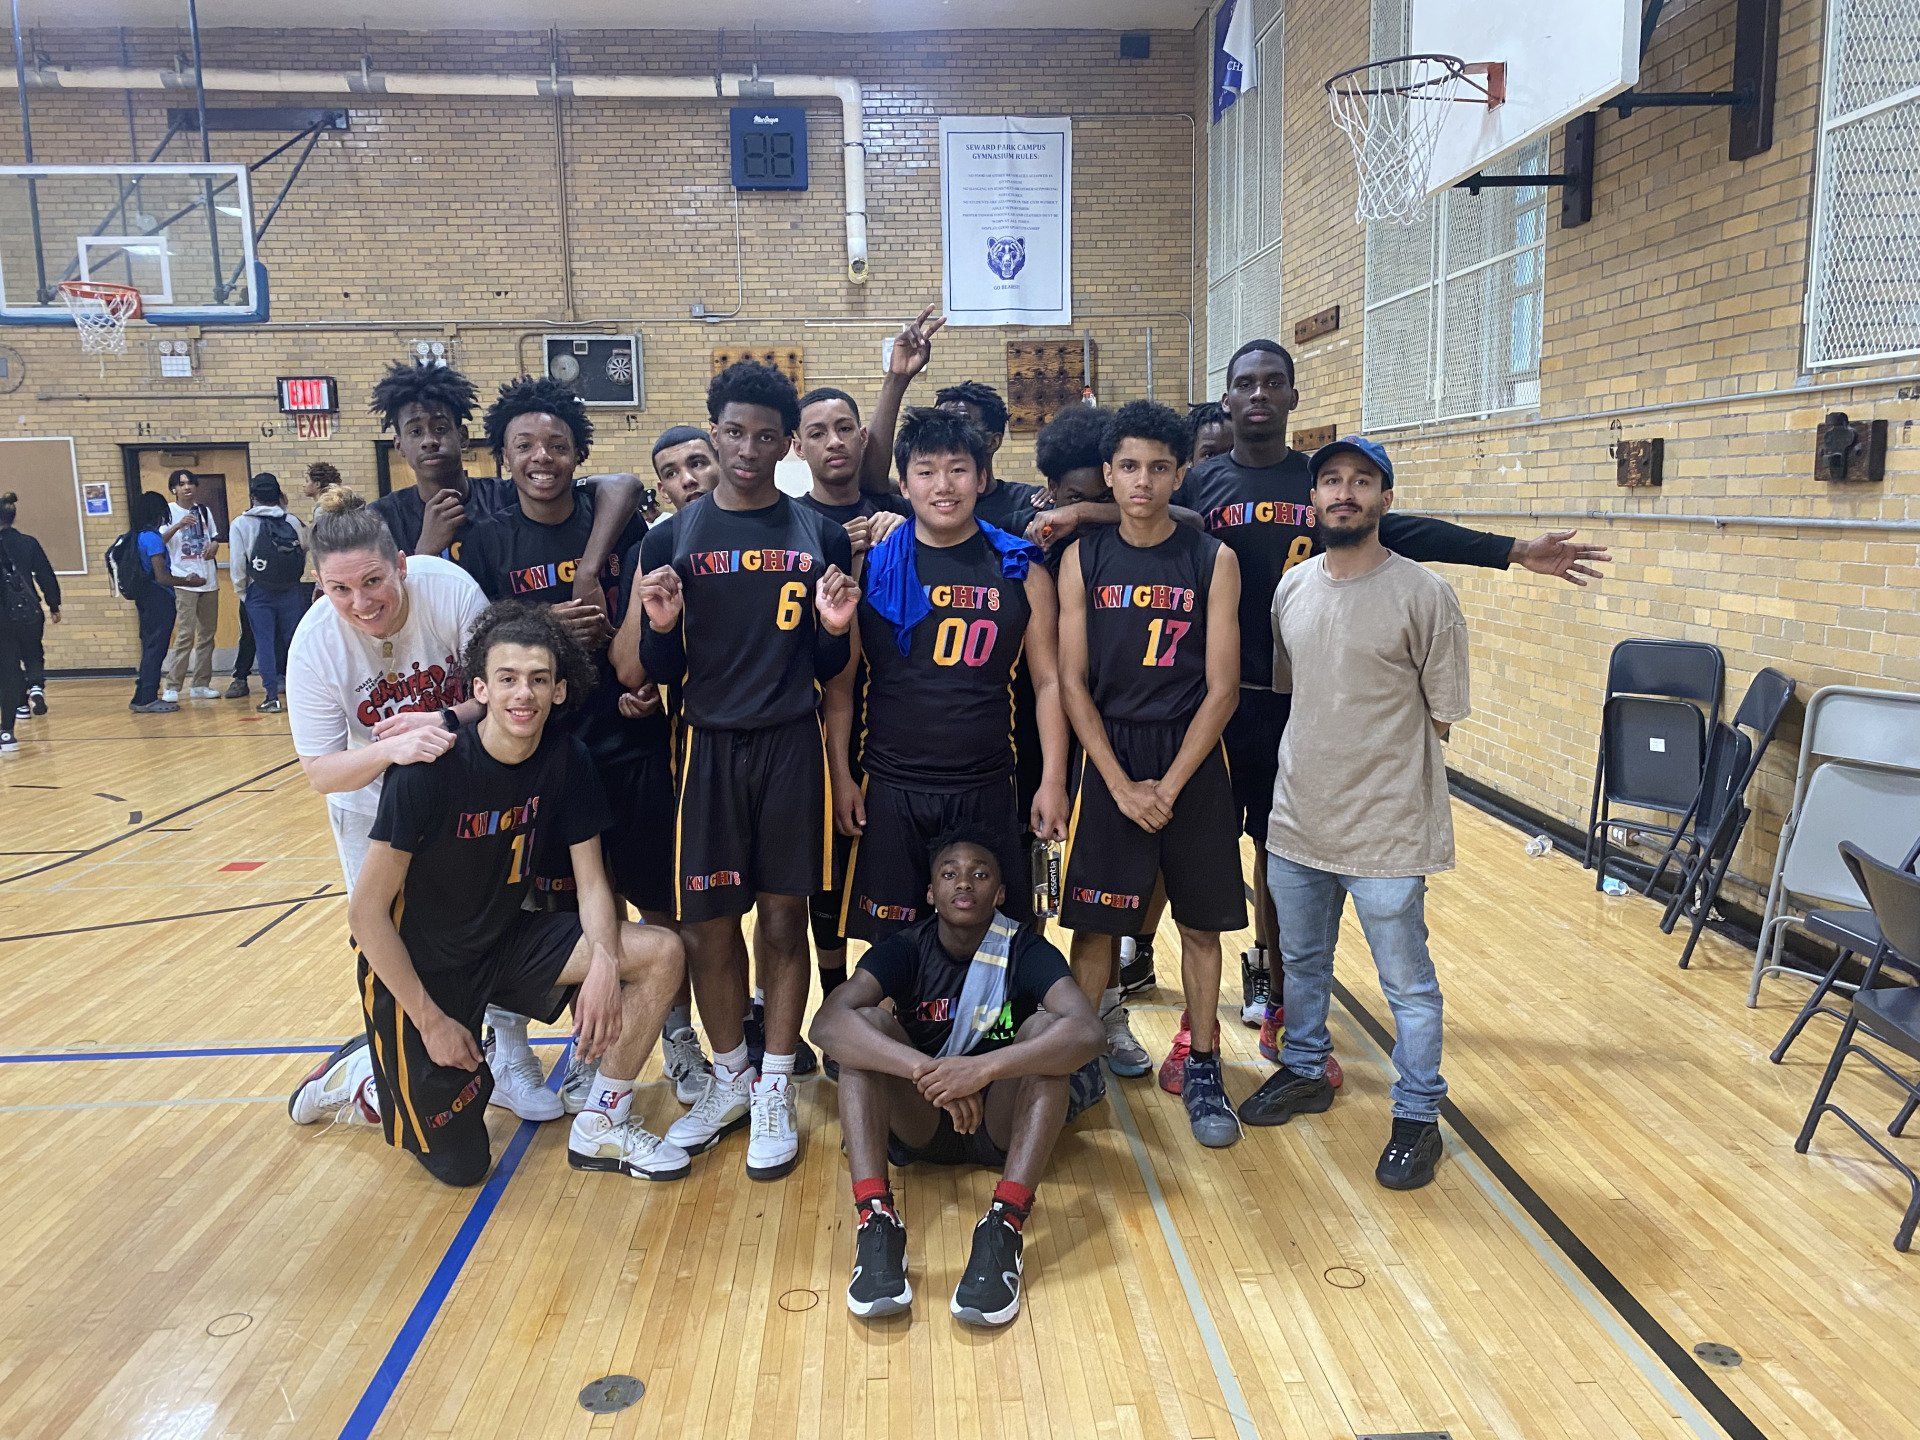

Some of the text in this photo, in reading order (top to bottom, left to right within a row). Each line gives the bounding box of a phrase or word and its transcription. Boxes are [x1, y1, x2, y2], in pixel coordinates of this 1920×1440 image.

[297, 414, 329, 437] EXIT
[1209, 501, 1316, 530] KNIGHTS
[689, 549, 814, 577] KNIGHTS
[775, 581, 808, 631] 6
[1093, 584, 1195, 613] KNIGHTS
[932, 617, 999, 667] 00
[1142, 618, 1192, 667] 17
[685, 870, 741, 891] KNIGHTS
[1049, 860, 1058, 896] essentia
[859, 894, 917, 922] KNIGHTS
[1072, 886, 1140, 909] KNIGHTS
